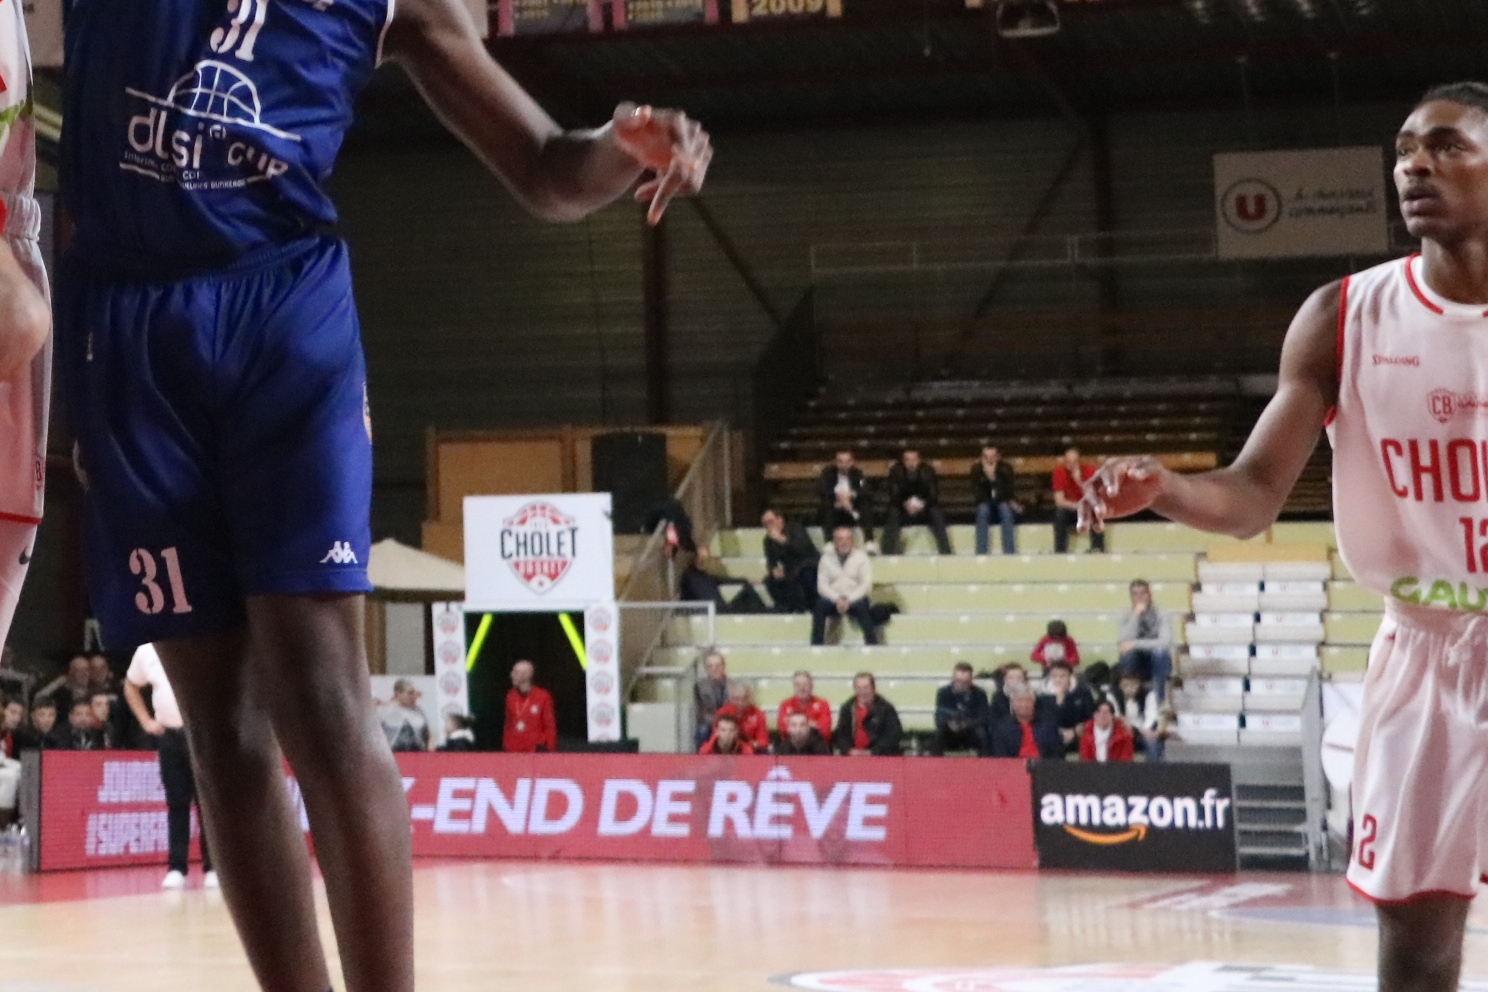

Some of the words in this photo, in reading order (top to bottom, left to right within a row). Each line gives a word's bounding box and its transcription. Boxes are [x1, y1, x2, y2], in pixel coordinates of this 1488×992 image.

[1234, 192, 1267, 222] U
[1431, 394, 1453, 416] CB
[1380, 438, 1488, 503] CHO
[500, 527, 580, 560] CHOLET
[128, 545, 193, 615] 31
[1390, 575, 1488, 613] GAU
[402, 776, 584, 836] -END
[597, 778, 709, 839] DE
[708, 764, 892, 841] RÊVE
[1039, 788, 1230, 831] amazon.fr
